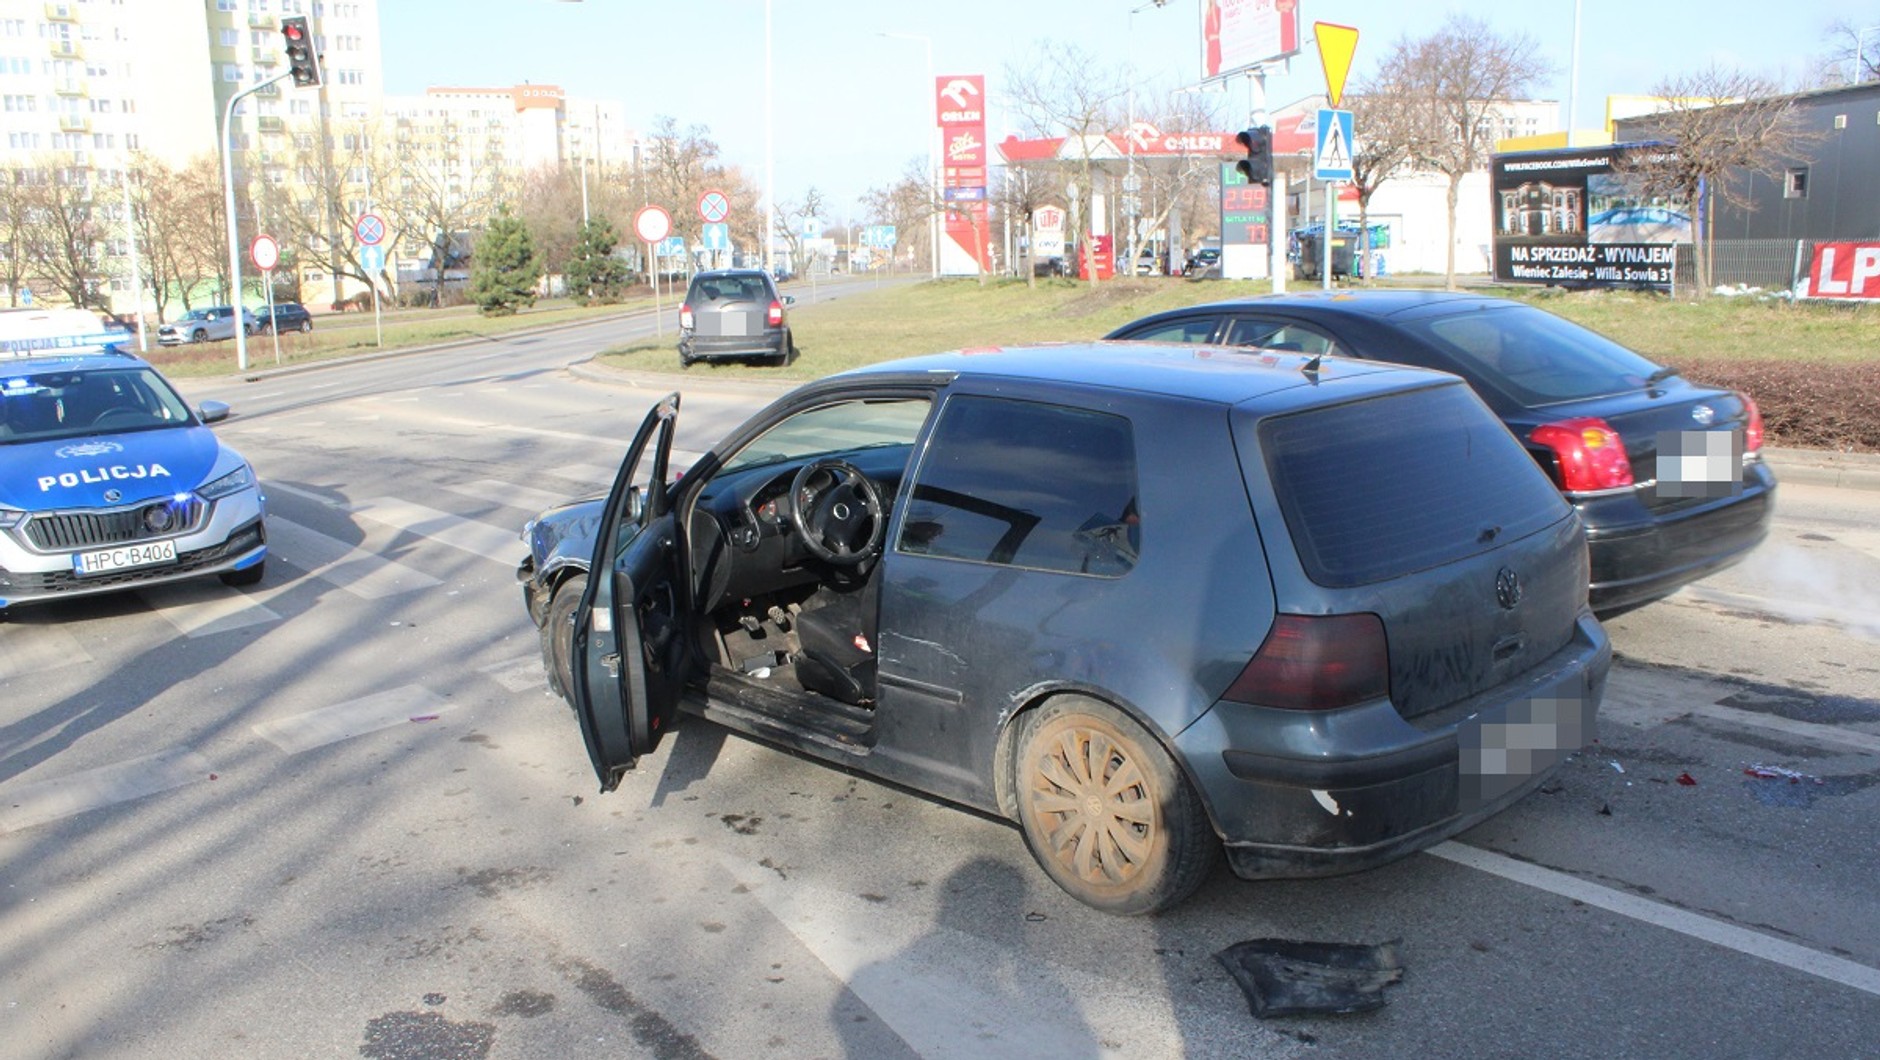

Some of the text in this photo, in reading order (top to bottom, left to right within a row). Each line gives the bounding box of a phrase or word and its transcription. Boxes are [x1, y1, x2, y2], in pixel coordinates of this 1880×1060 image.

[941, 110, 981, 122] ORLEN
[1165, 136, 1223, 150] ORLEN
[1224, 189, 1267, 210] 2.99
[1512, 247, 1530, 262] NA
[1532, 244, 1596, 263] SPRZEDAŻ
[1604, 246, 1673, 264] WYNAJEM
[1512, 265, 1550, 278] Wieniec
[1551, 265, 1588, 279] Zalesie
[1595, 266, 1622, 280] Willa
[1624, 267, 1658, 282] Sowia
[37, 463, 171, 492] POLICJA
[85, 545, 172, 572] HPC B406
